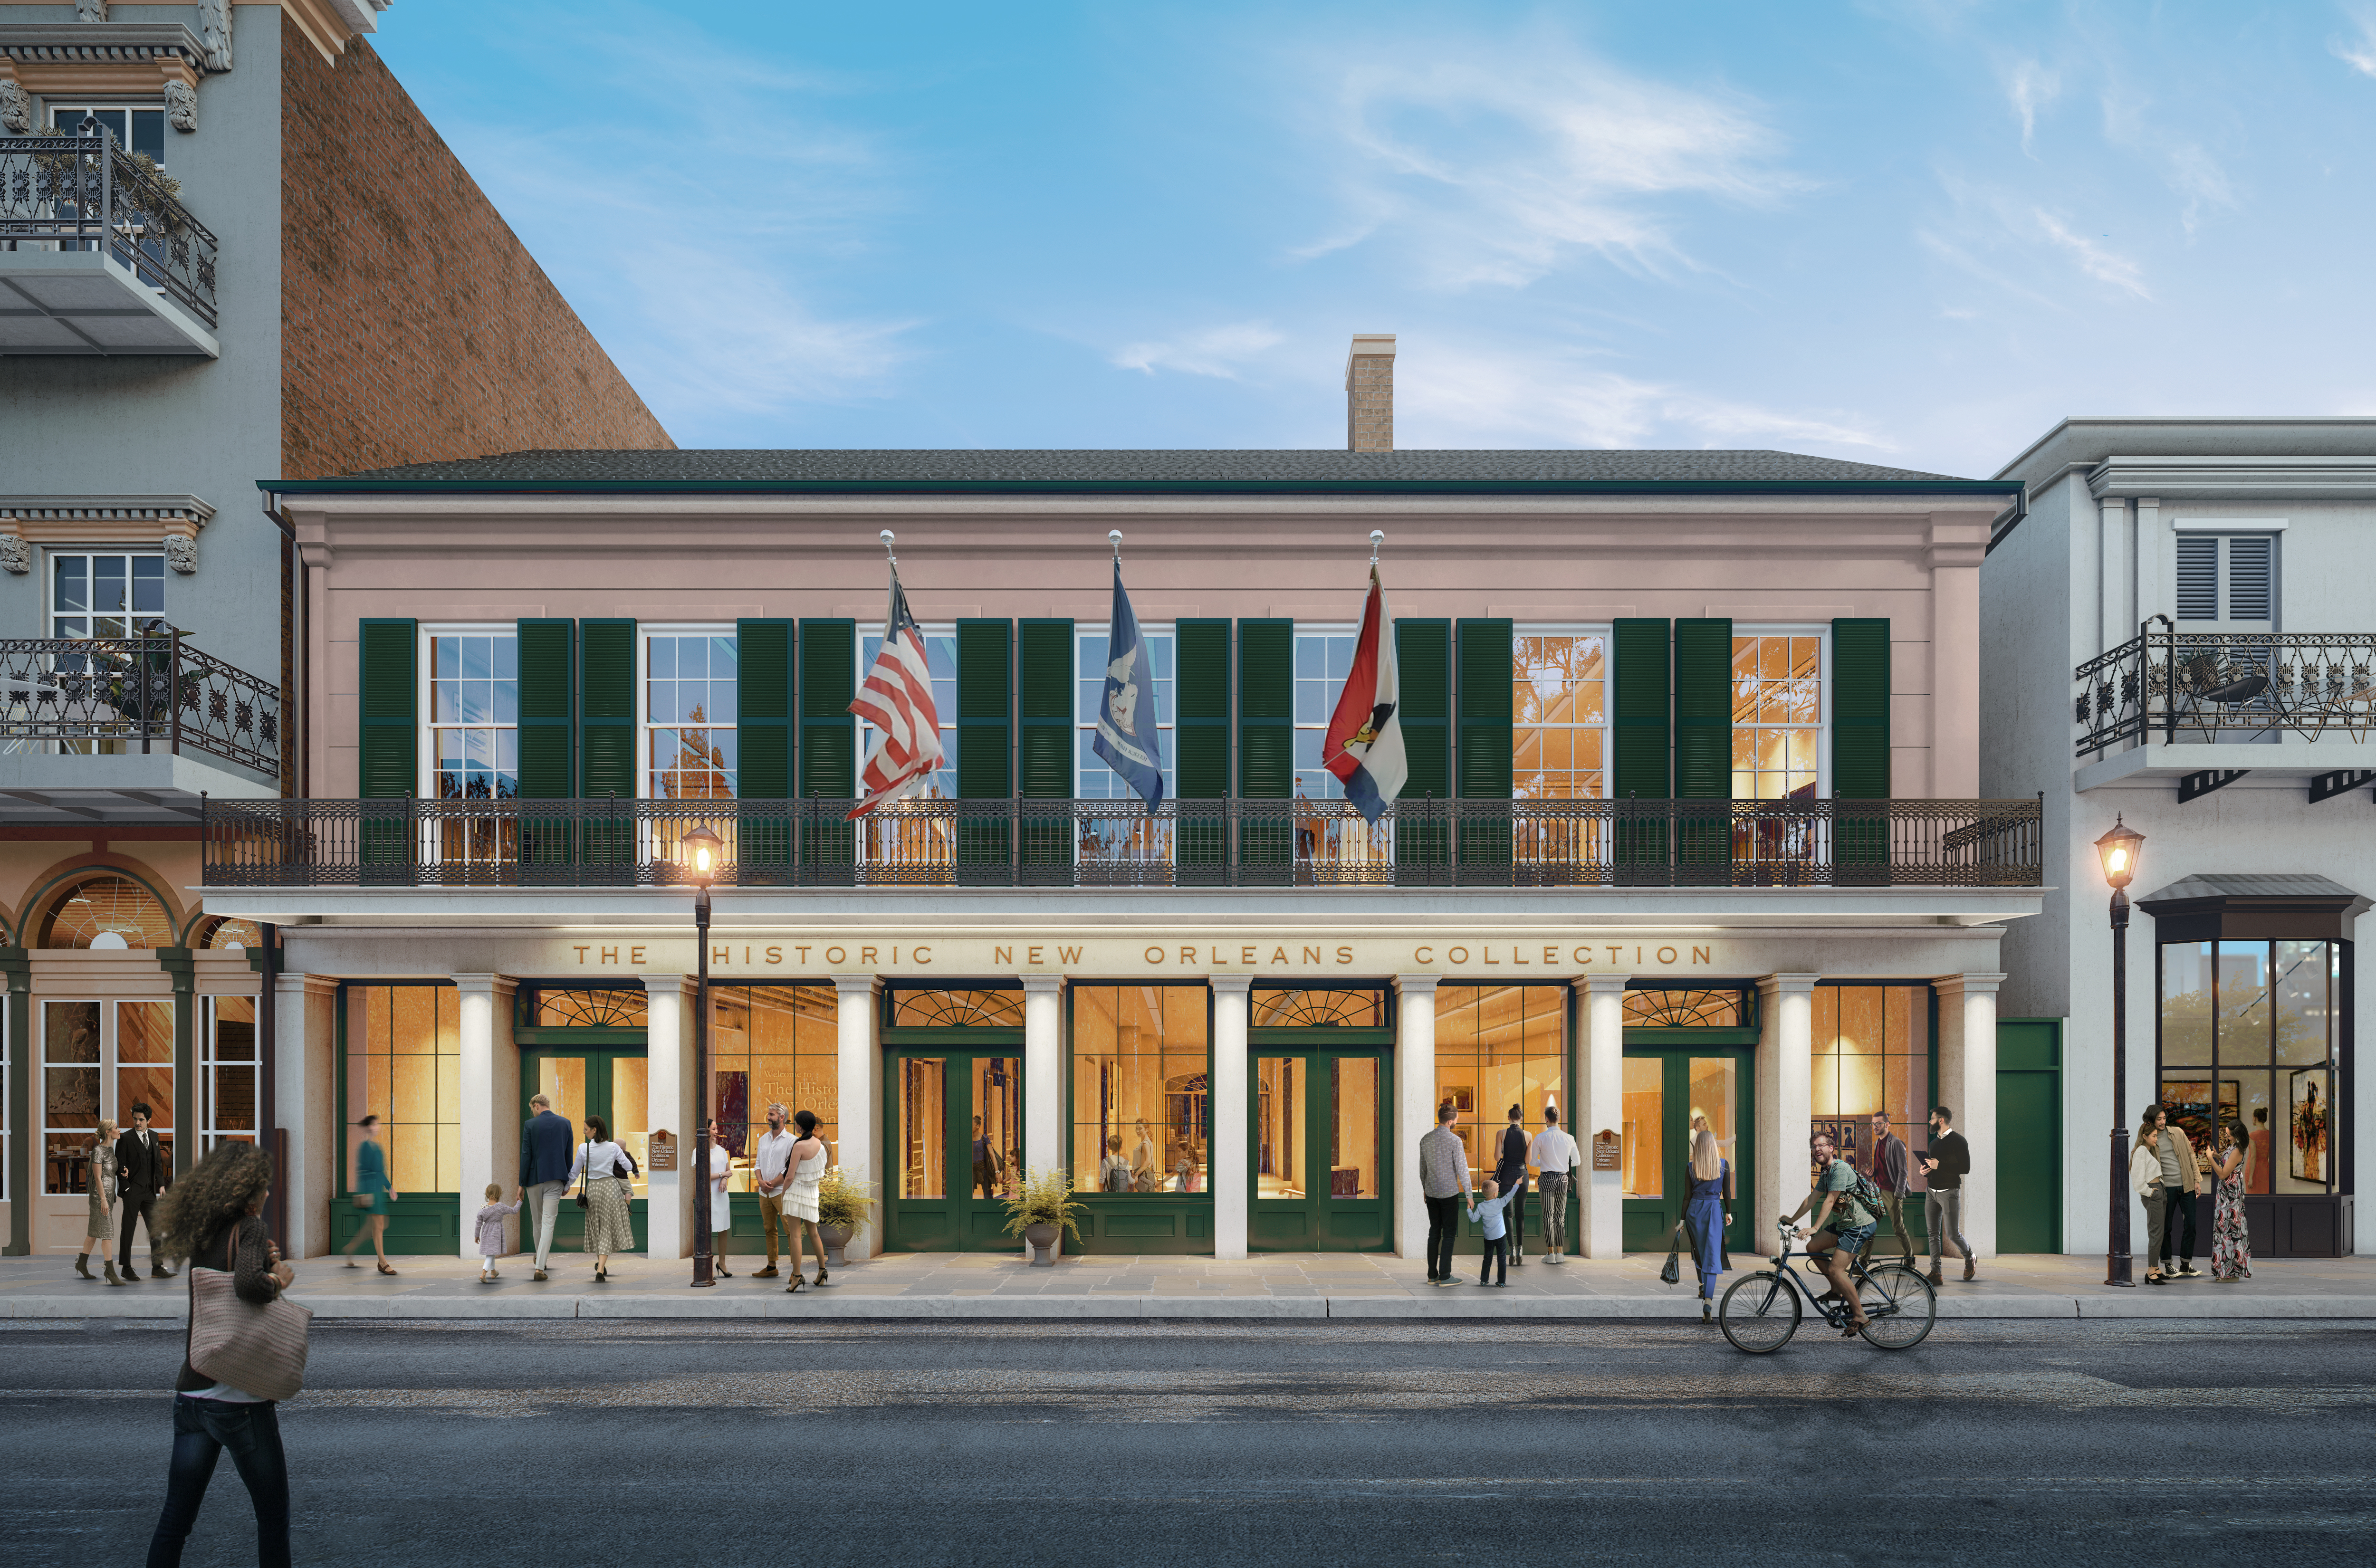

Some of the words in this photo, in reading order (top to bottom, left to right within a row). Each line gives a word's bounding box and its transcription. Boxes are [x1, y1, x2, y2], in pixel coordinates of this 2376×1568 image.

[574, 946, 646, 964] THE
[712, 946, 932, 964] HISTORIC
[995, 946, 1083, 964] NEW
[1145, 946, 1353, 964] ORLEANS
[1415, 946, 1710, 964] COLLECTION
[764, 1081, 793, 1095] The
[797, 1082, 838, 1095] Histo
